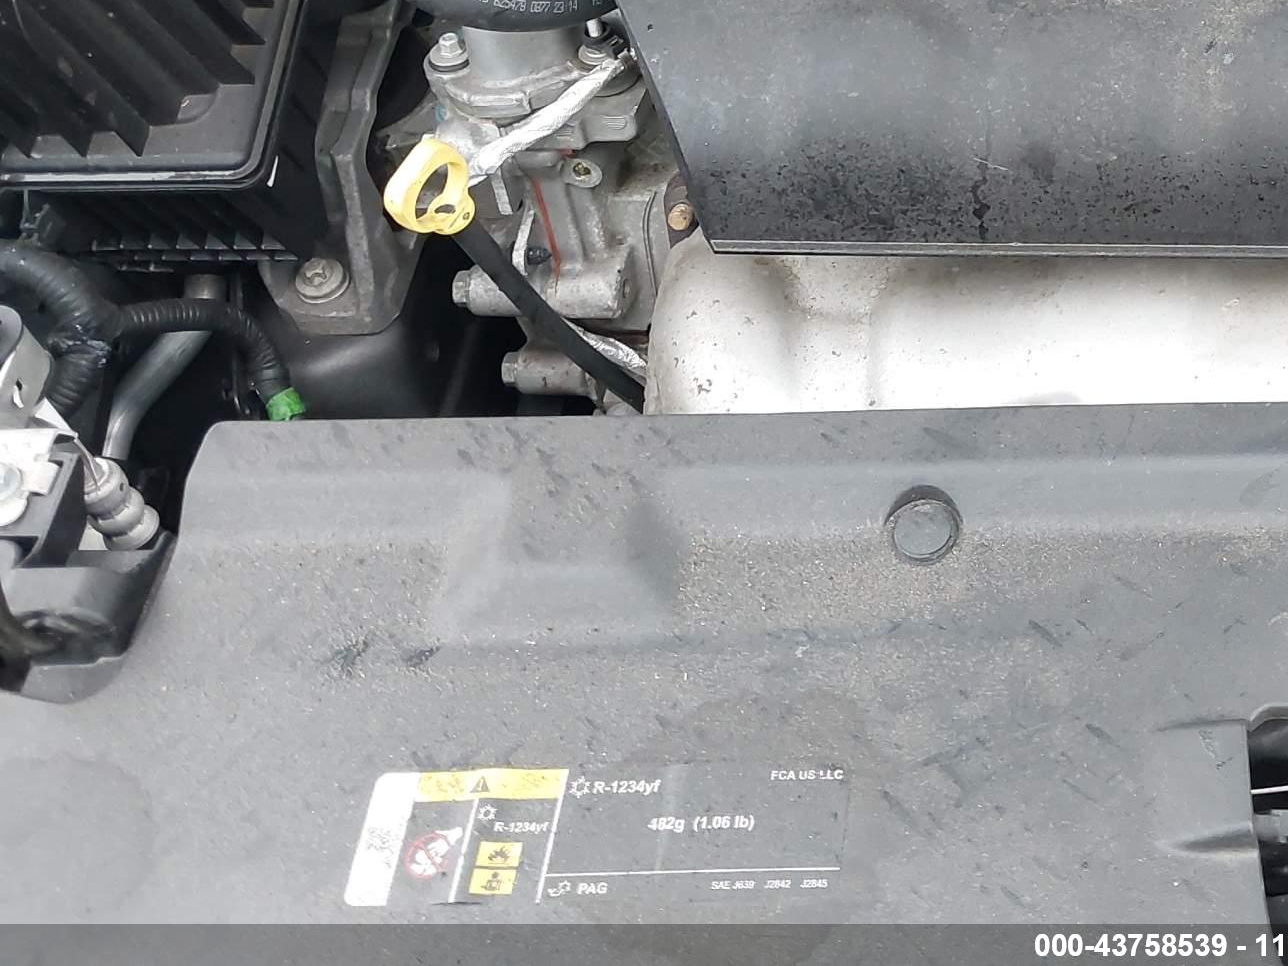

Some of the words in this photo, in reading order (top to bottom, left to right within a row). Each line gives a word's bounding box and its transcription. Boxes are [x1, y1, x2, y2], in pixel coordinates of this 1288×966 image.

[770, 769, 797, 781] FCA
[798, 769, 817, 780] US
[818, 769, 845, 781] LLC
[592, 778, 662, 796] R-1234yf
[493, 821, 550, 835] R-1234yf
[647, 817, 686, 834] 482g
[692, 815, 732, 832] (1.06
[733, 814, 756, 832] lb)
[577, 881, 609, 895] PAG
[710, 880, 732, 891] SAE
